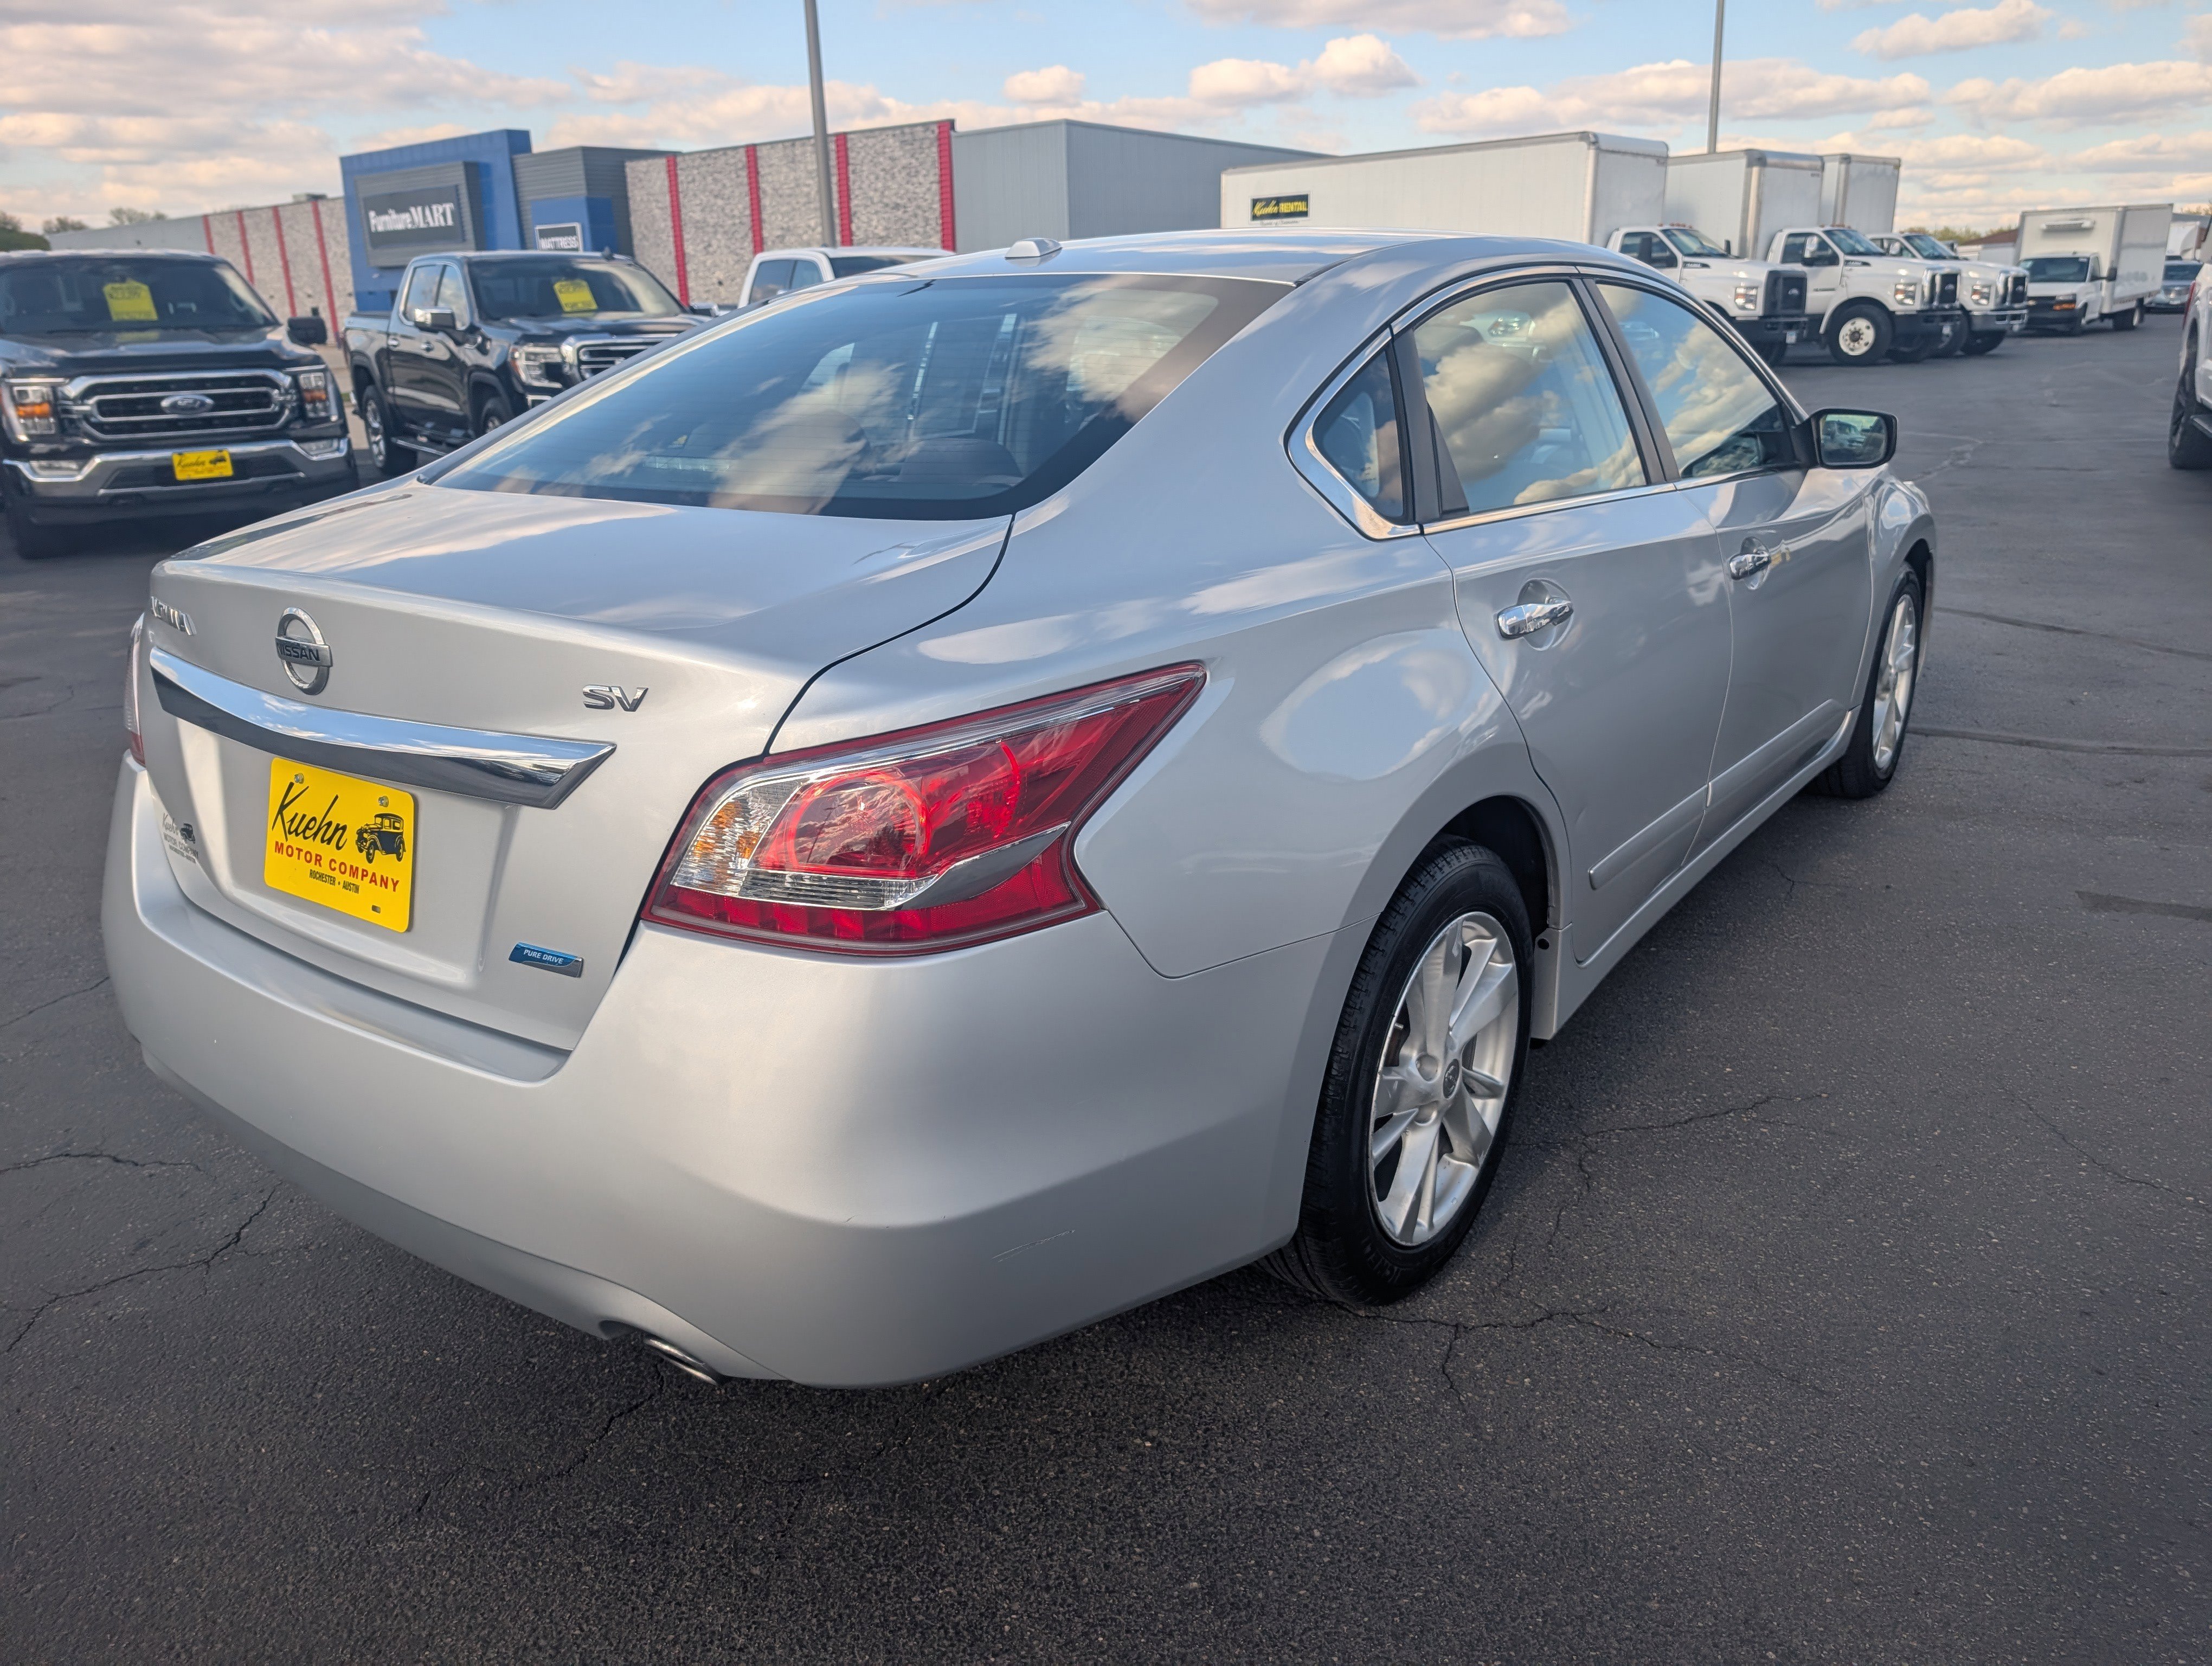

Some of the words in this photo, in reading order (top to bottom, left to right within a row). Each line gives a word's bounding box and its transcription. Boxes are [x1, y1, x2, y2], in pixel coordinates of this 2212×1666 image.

[1279, 201, 1308, 213] RENTAL
[538, 235, 578, 249] MATTRESS
[151, 596, 197, 636] LTIMA
[276, 642, 320, 662] NISSAN
[583, 684, 648, 712] SV
[272, 781, 348, 851] Kuehn
[275, 841, 323, 867] MOTOR
[329, 858, 400, 892] COMPANY
[309, 869, 336, 887] ROCHESTER
[342, 880, 360, 894] AUSTIN
[523, 949, 542, 959] PURE
[542, 954, 564, 964] DRIVE
